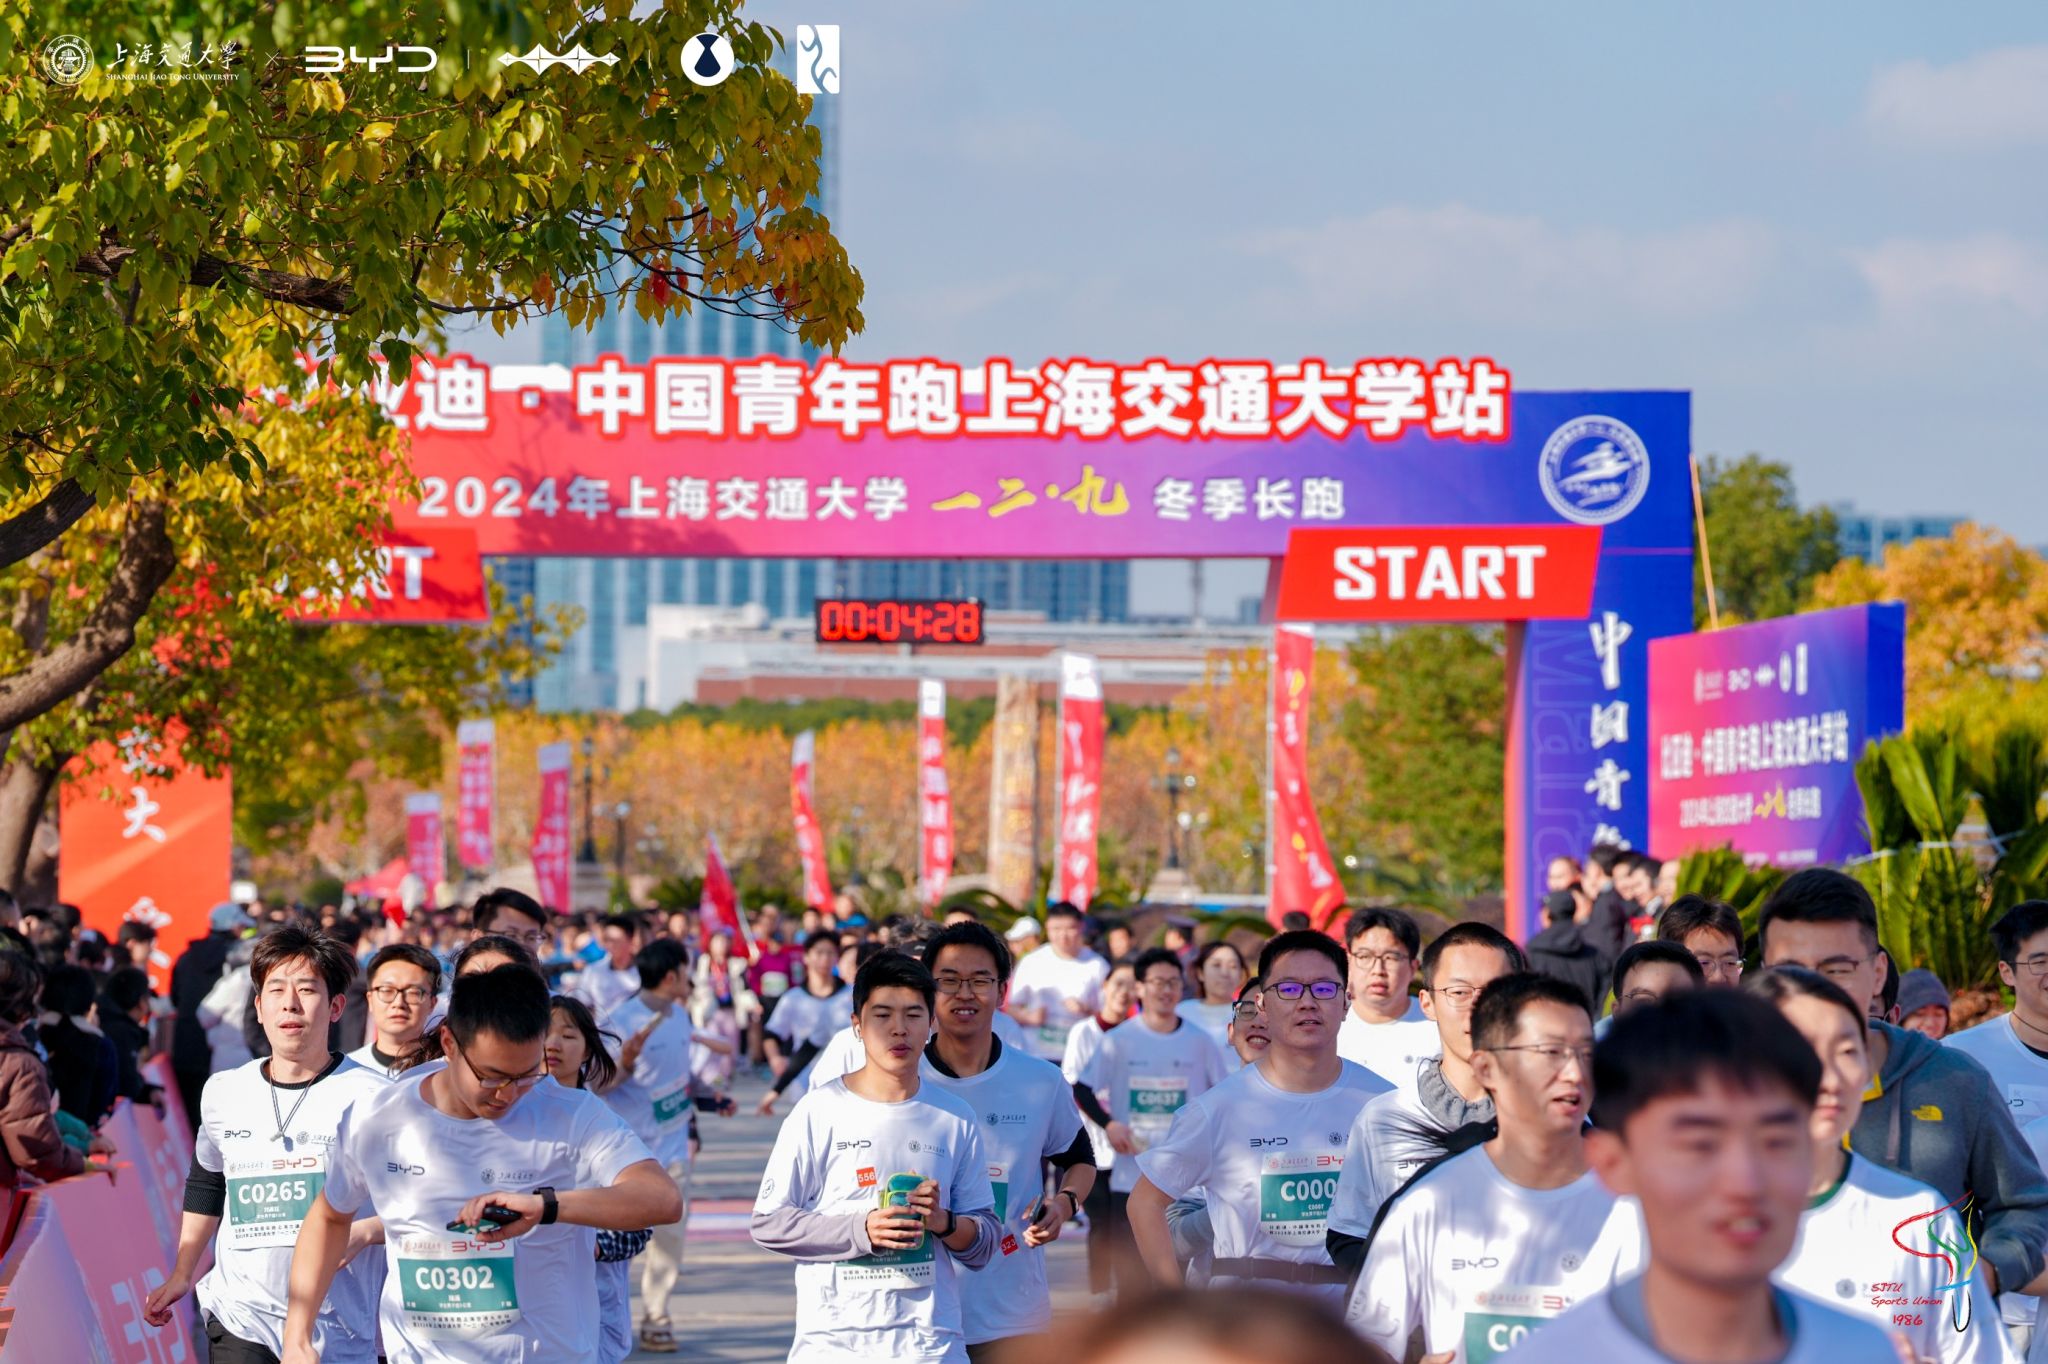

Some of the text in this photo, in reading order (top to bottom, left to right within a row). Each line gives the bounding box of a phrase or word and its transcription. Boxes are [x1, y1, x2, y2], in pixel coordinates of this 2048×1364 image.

[417, 475, 908, 521] 2024年上海交通大学
[1153, 477, 1345, 521] 冬季长跑
[1333, 545, 1547, 601] START
[821, 601, 980, 642] 00:04:28
[224, 1130, 252, 1138] BYD
[836, 1140, 872, 1150] BYD
[1250, 1137, 1288, 1148] BYD
[272, 1157, 318, 1169] BYD
[1316, 1155, 1344, 1167] BY
[1397, 1159, 1423, 1170] BY
[387, 1162, 425, 1176] BYD
[857, 1173, 876, 1184] 556
[238, 1181, 307, 1204] C0265
[1281, 1178, 1337, 1202] C000
[451, 1240, 506, 1253] BYD
[1452, 1257, 1499, 1270] BYD
[415, 1266, 495, 1290] C0302
[1487, 1324, 1530, 1352] C0
